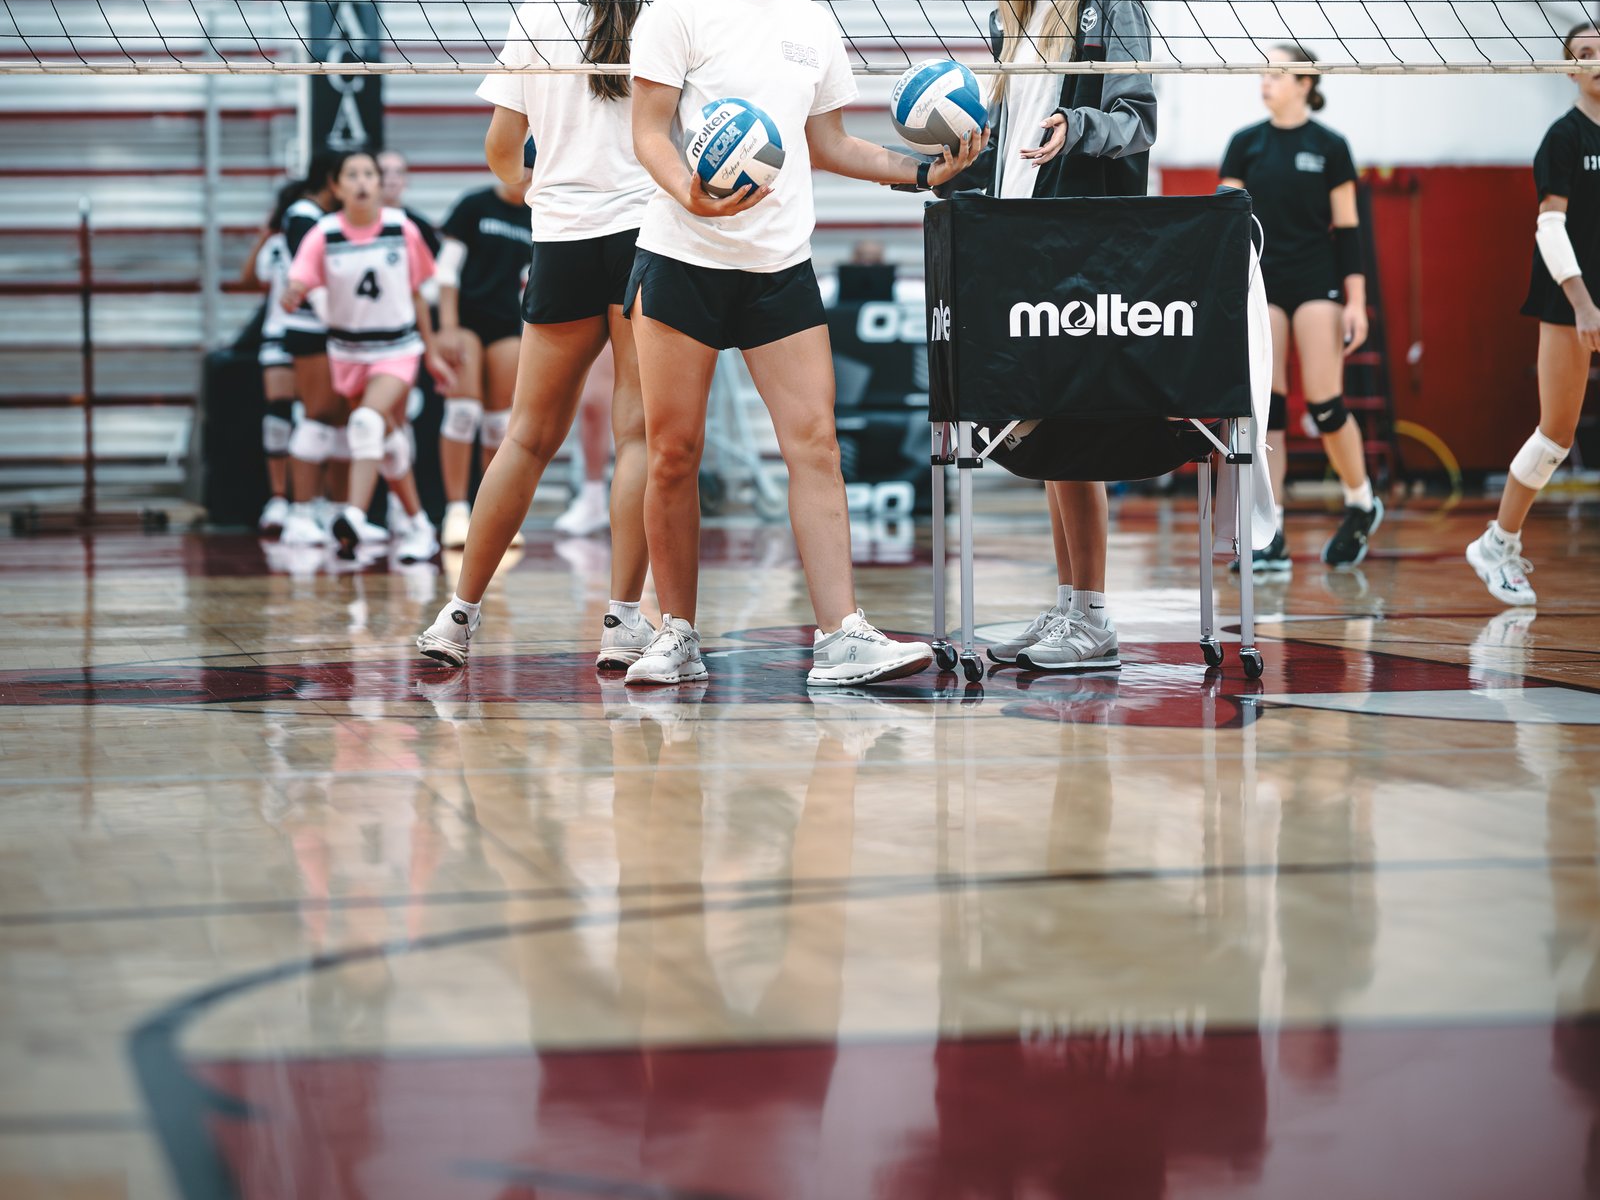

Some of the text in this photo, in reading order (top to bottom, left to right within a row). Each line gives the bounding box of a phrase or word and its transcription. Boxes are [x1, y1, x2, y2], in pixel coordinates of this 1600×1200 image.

[692, 110, 731, 158] molten
[704, 122, 743, 169] NCAA
[721, 161, 740, 180] Super
[357, 269, 380, 300] 4
[1010, 294, 1193, 337] molten
